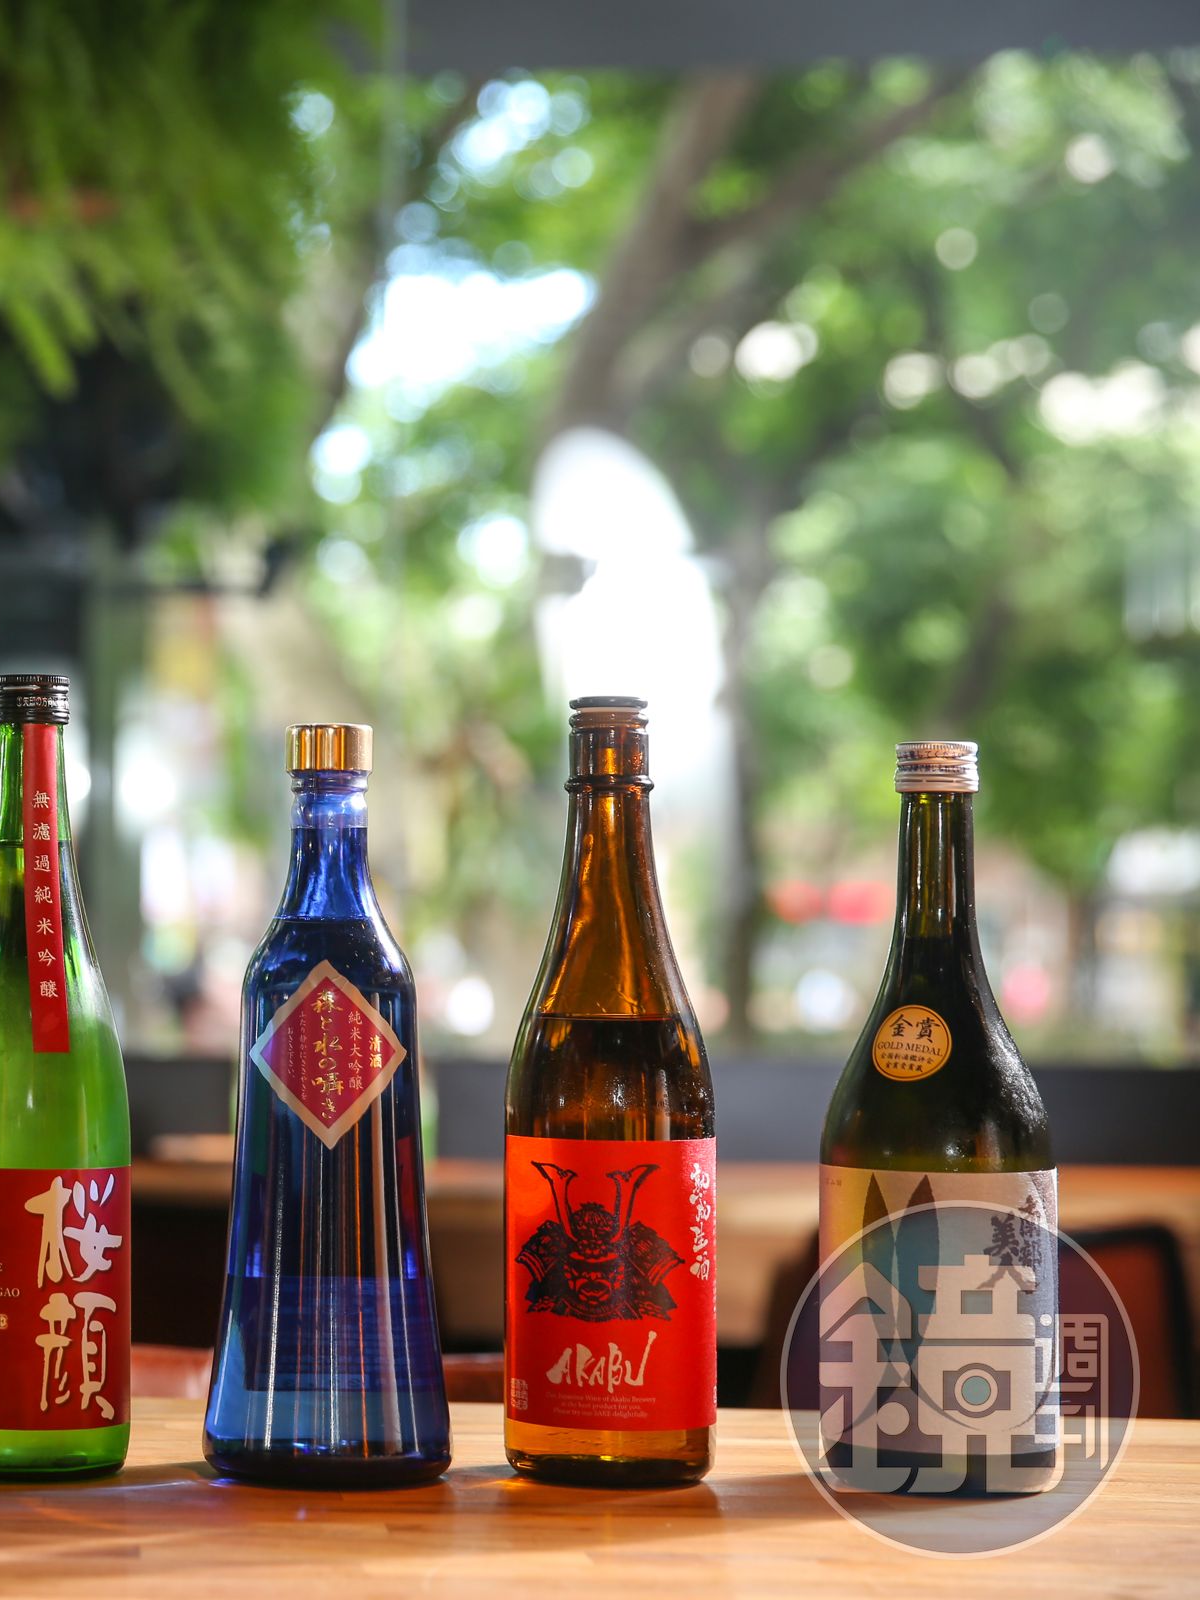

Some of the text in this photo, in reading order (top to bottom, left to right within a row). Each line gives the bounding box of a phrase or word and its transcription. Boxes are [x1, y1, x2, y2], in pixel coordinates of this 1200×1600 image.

[32, 790, 59, 998] 無濾過純米吟醸
[348, 1011, 363, 1090] 純米大吟醸
[369, 1034, 382, 1069] 清酒
[877, 1041, 943, 1057] GOLD MEDAL
[889, 1014, 941, 1043] 金賞
[23, 1173, 123, 1421] 桜顔
